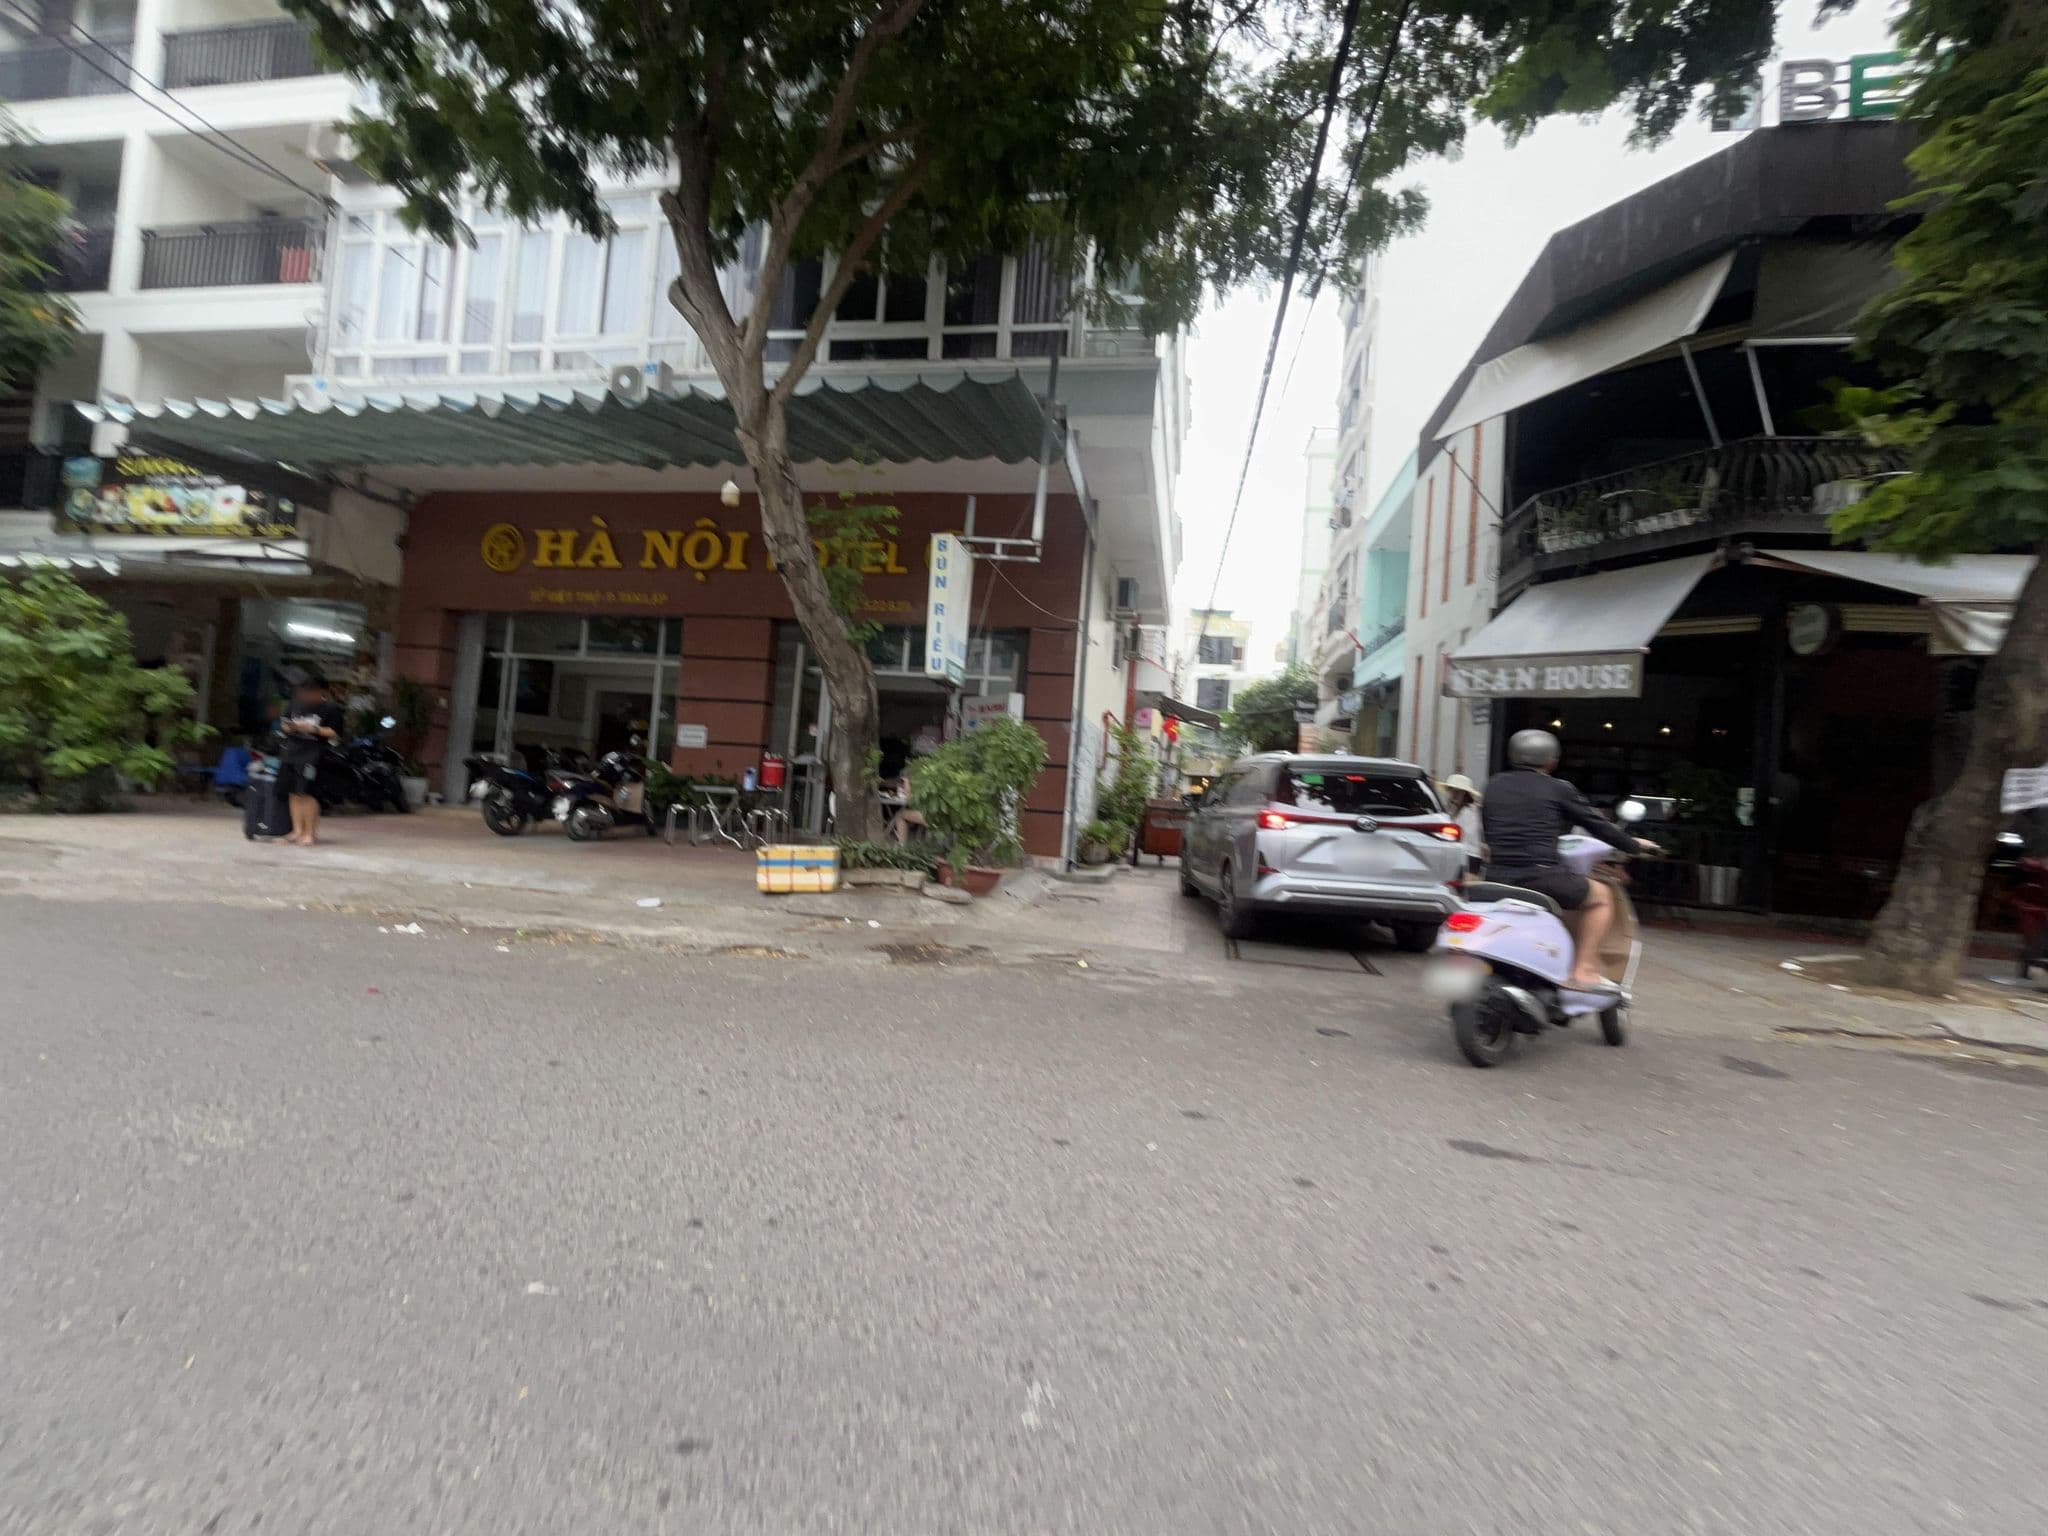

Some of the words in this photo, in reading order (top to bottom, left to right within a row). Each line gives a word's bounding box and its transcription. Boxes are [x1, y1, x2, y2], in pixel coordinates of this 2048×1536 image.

[531, 514, 623, 569] HÀ
[638, 516, 750, 582] NỘI
[1544, 664, 1633, 690] HOUSE
